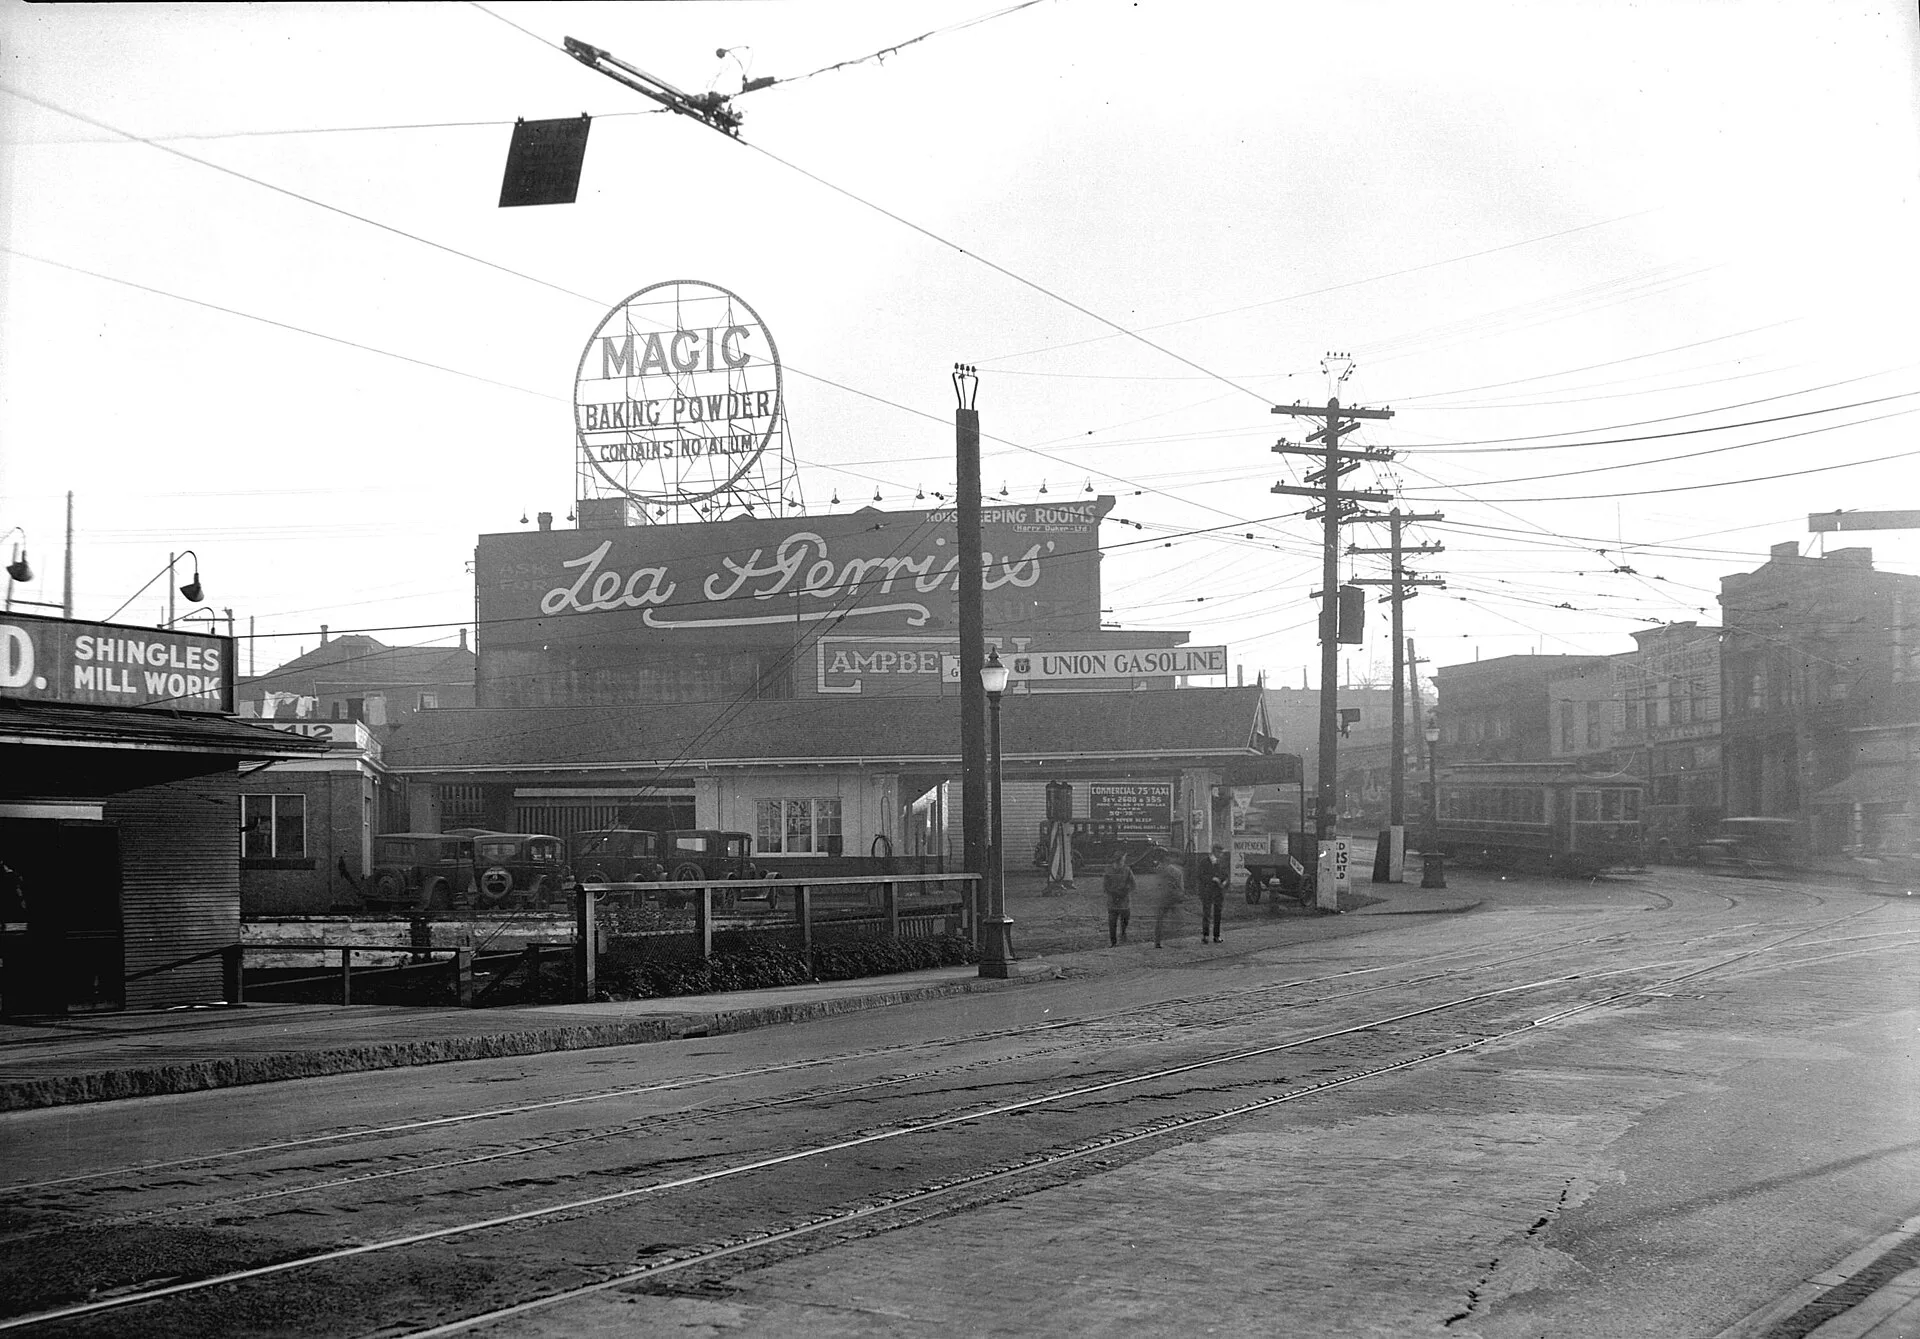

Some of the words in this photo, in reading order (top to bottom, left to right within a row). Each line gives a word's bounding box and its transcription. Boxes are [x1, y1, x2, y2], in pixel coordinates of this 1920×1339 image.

[602, 326, 751, 379] MAGIC
[586, 400, 660, 430] BAKING
[673, 391, 770, 424] POWDER
[600, 440, 674, 462] CONTAINS
[682, 438, 701, 456] NO
[709, 434, 752, 454] ALUM
[926, 508, 1028, 523] HOUSEPING
[1034, 505, 1097, 524] ROOMS
[541, 540, 676, 614] Lea
[74, 636, 220, 672] SHINGLES
[1042, 654, 1107, 674] UNION
[1114, 650, 1224, 673] GASOLINE
[74, 665, 137, 694] MILL
[144, 671, 221, 700] WORK
[1091, 786, 1136, 795] COMMERCIAL
[1137, 786, 1148, 795] 75
[1151, 786, 1169, 795] TAXI
